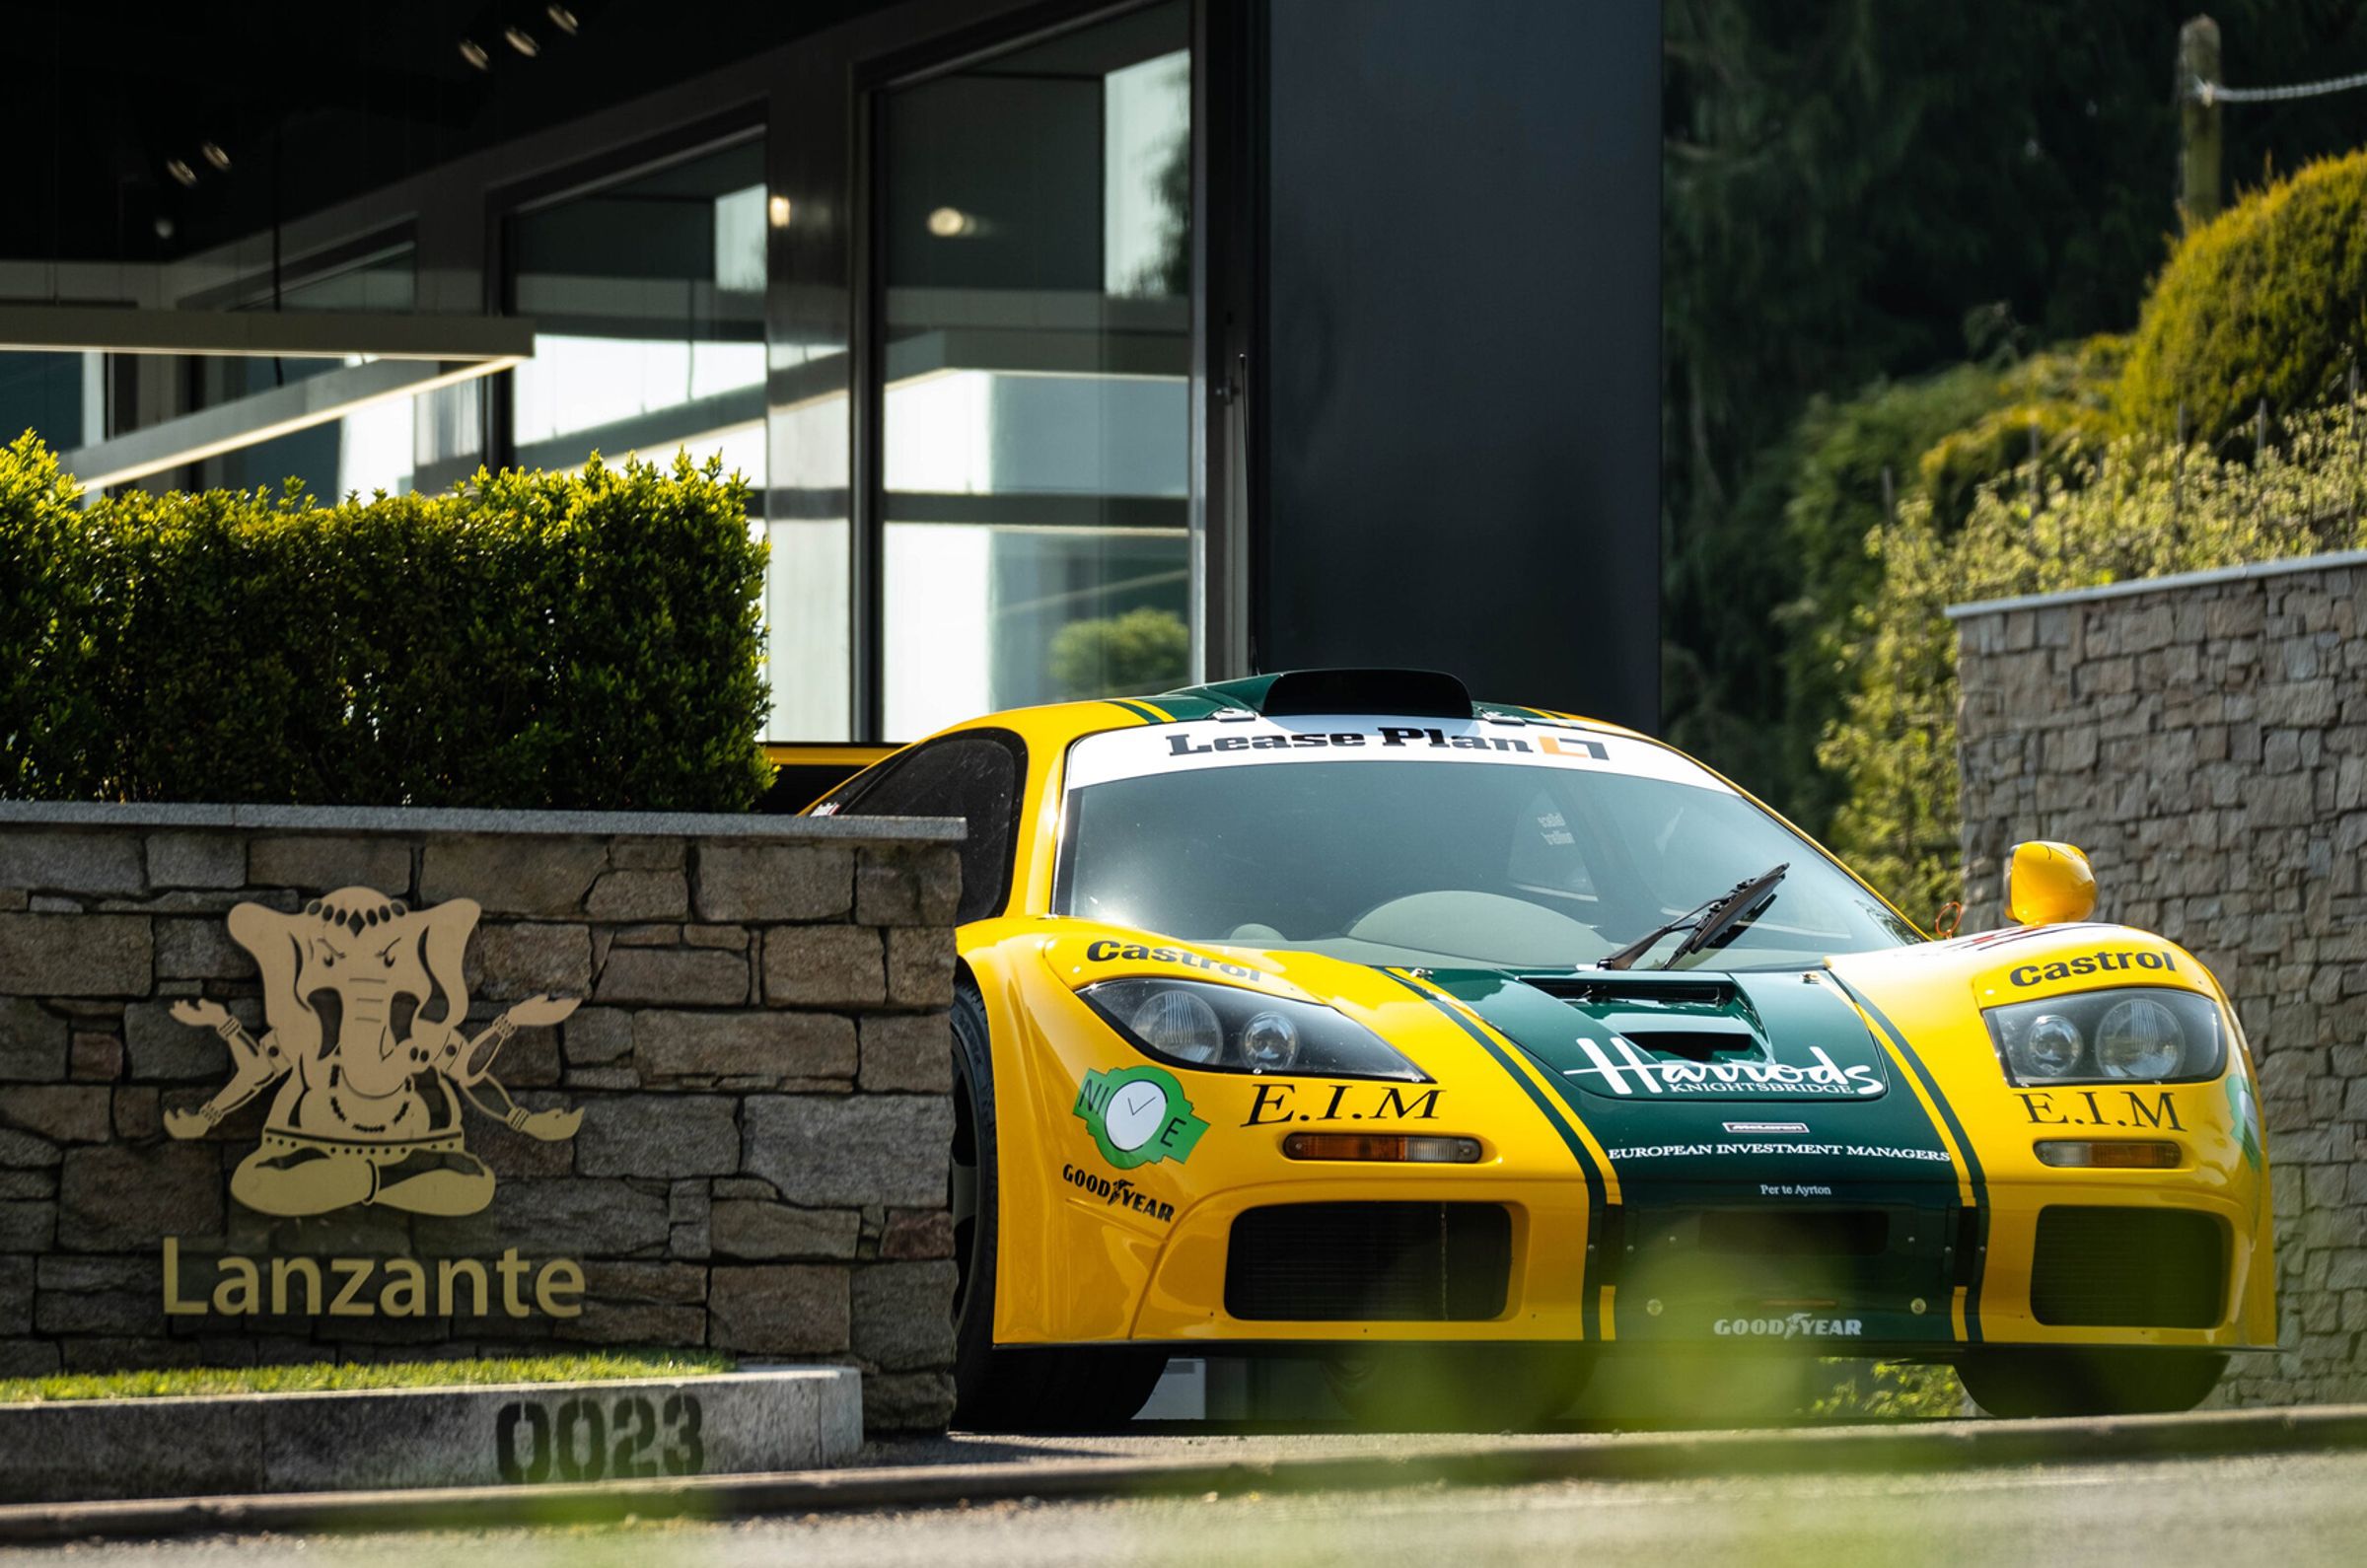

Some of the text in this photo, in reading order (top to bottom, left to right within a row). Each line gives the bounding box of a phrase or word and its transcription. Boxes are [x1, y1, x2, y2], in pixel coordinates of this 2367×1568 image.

[1166, 727, 1534, 756] Lease Plan
[1087, 940, 1260, 980] Castrol
[2010, 951, 2177, 987] Castrol
[1564, 1037, 1884, 1095] Harrods
[1240, 1084, 1447, 1127] E.I.M
[1671, 1082, 1855, 1094] KNIGHTSBRIDGE
[2013, 1092, 2188, 1132] E.I.M
[1609, 1144, 1951, 1161] EUROPEAN INVESTMENT MANAGERS
[1062, 1164, 1175, 1224] GOODYEAR
[1759, 1184, 1831, 1197] Per te Ayrton
[163, 1237, 586, 1319] Lanzante
[1713, 1313, 1862, 1339] GOODYEAR
[496, 1393, 702, 1479] 0023
